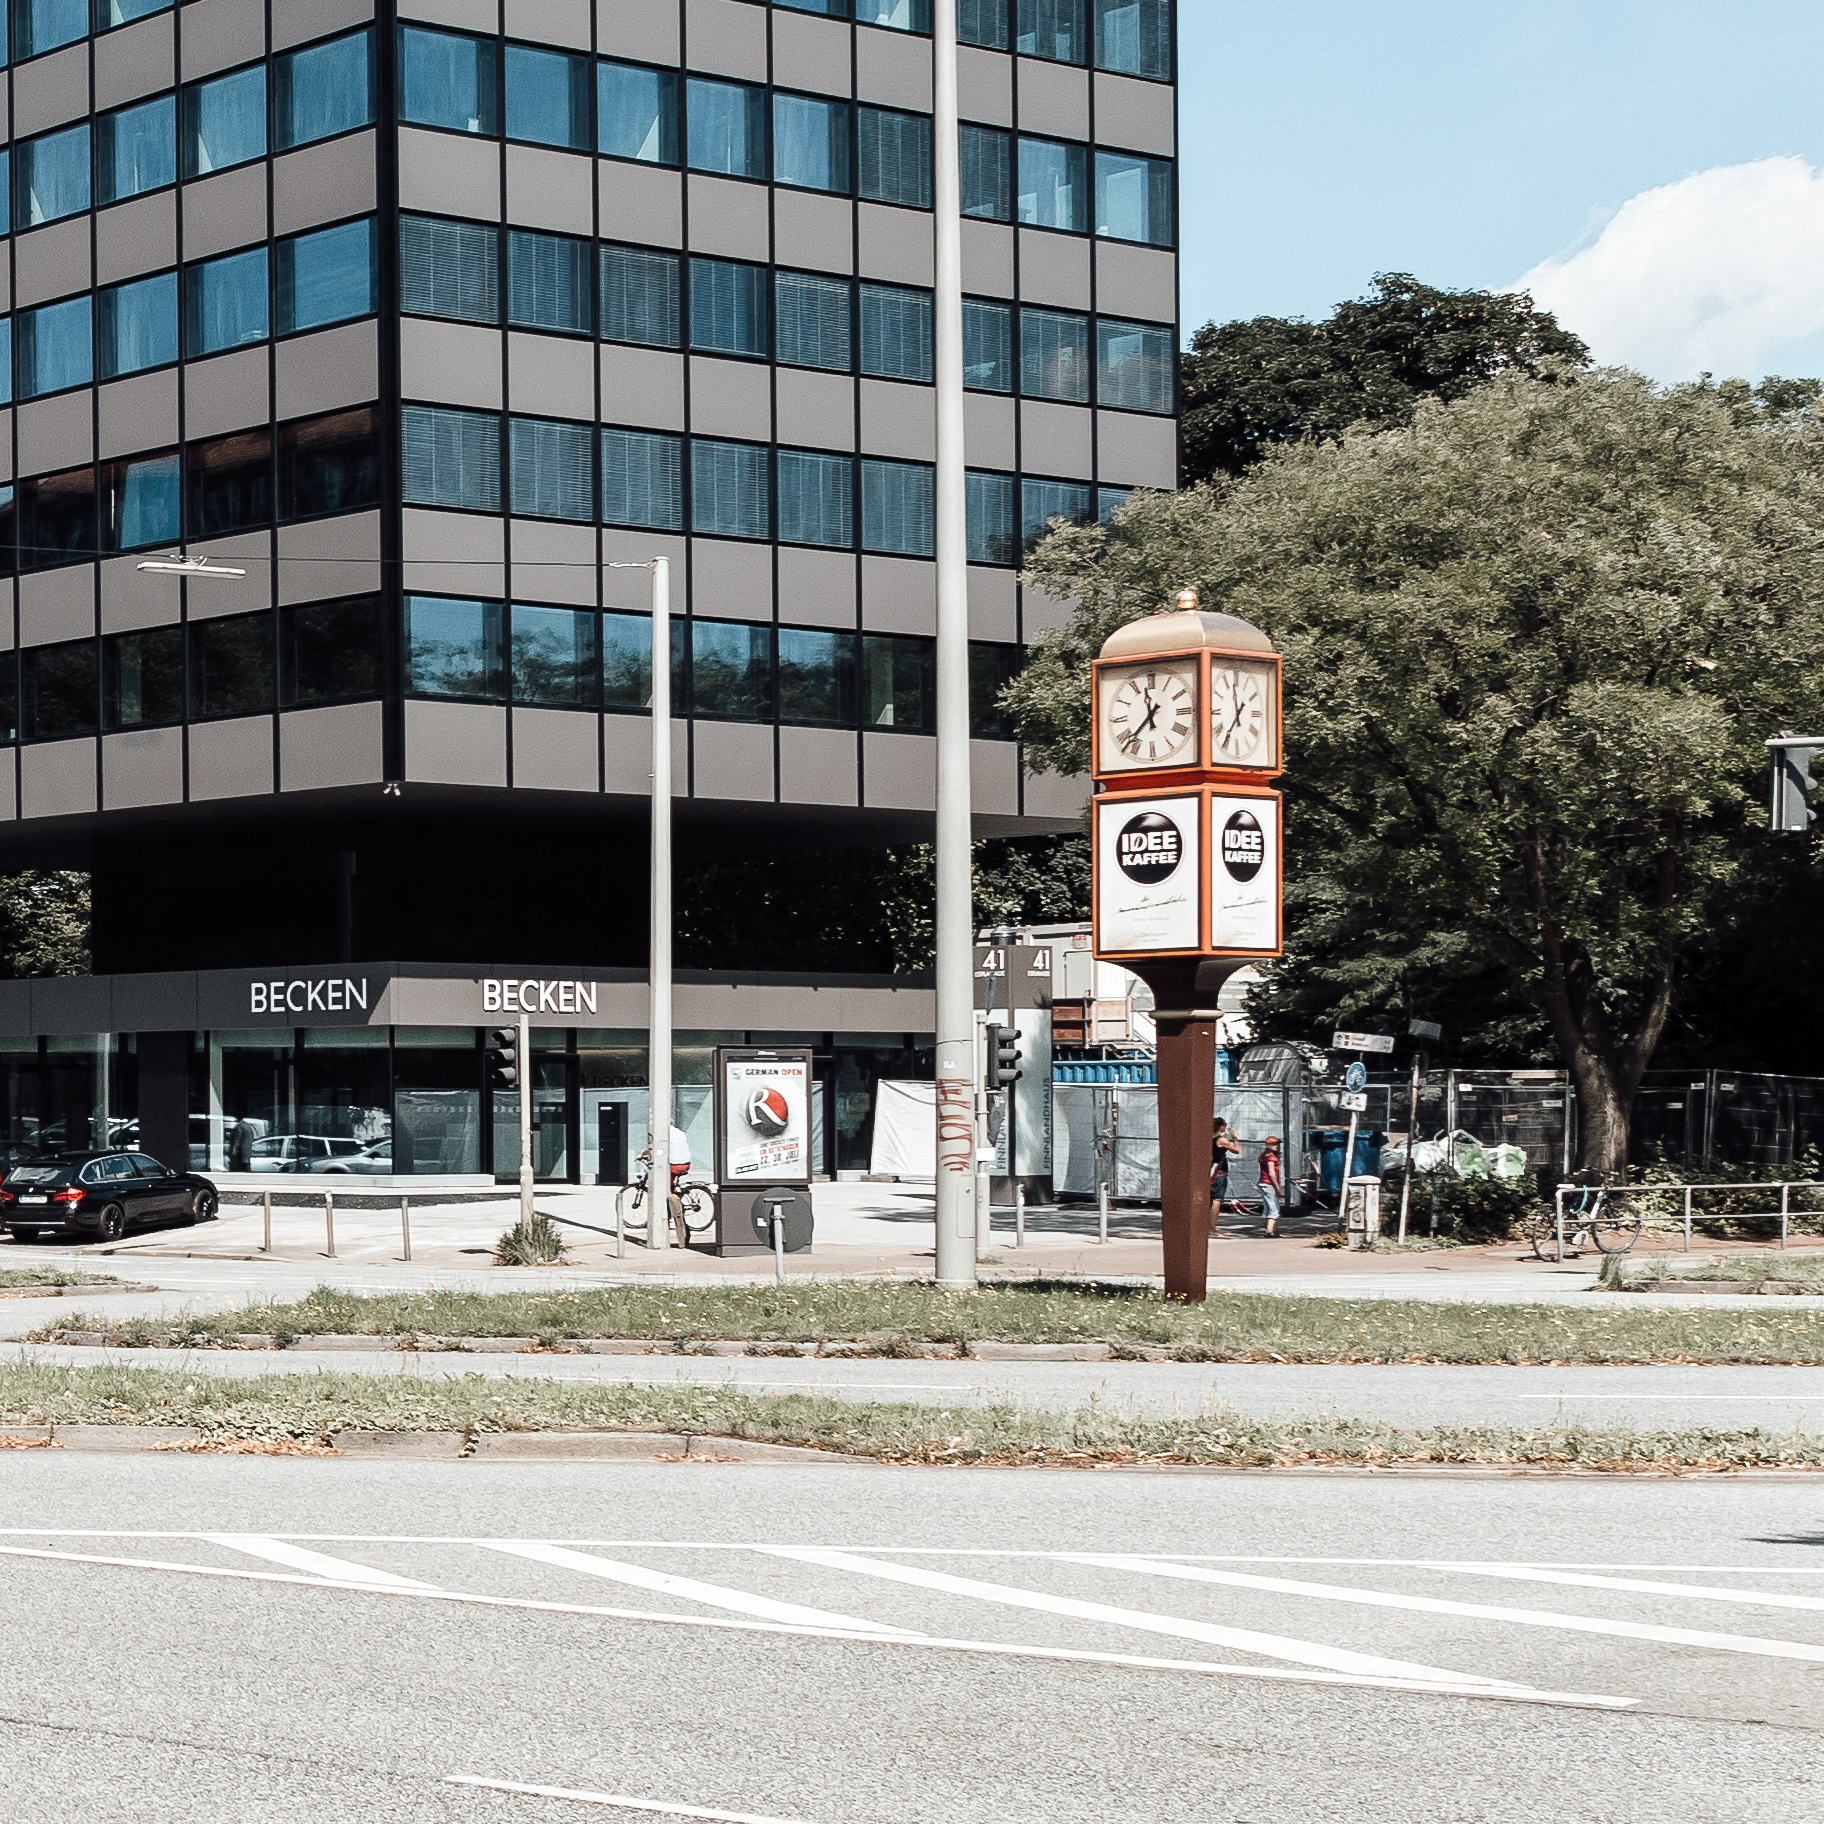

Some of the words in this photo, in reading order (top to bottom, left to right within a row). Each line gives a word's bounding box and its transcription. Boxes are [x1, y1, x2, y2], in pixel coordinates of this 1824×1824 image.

[1121, 831, 1178, 852] IDEE
[1224, 829, 1262, 849] IDEE
[1121, 851, 1178, 866] KAFFEE
[1224, 850, 1262, 864] KAFFEE
[982, 949, 1005, 970] 41
[1032, 949, 1050, 970] 41
[250, 978, 367, 1013] BECKEN
[483, 979, 597, 1014] BECKEN
[745, 1068, 779, 1076] GERMAN
[781, 1068, 803, 1076] OPEN
